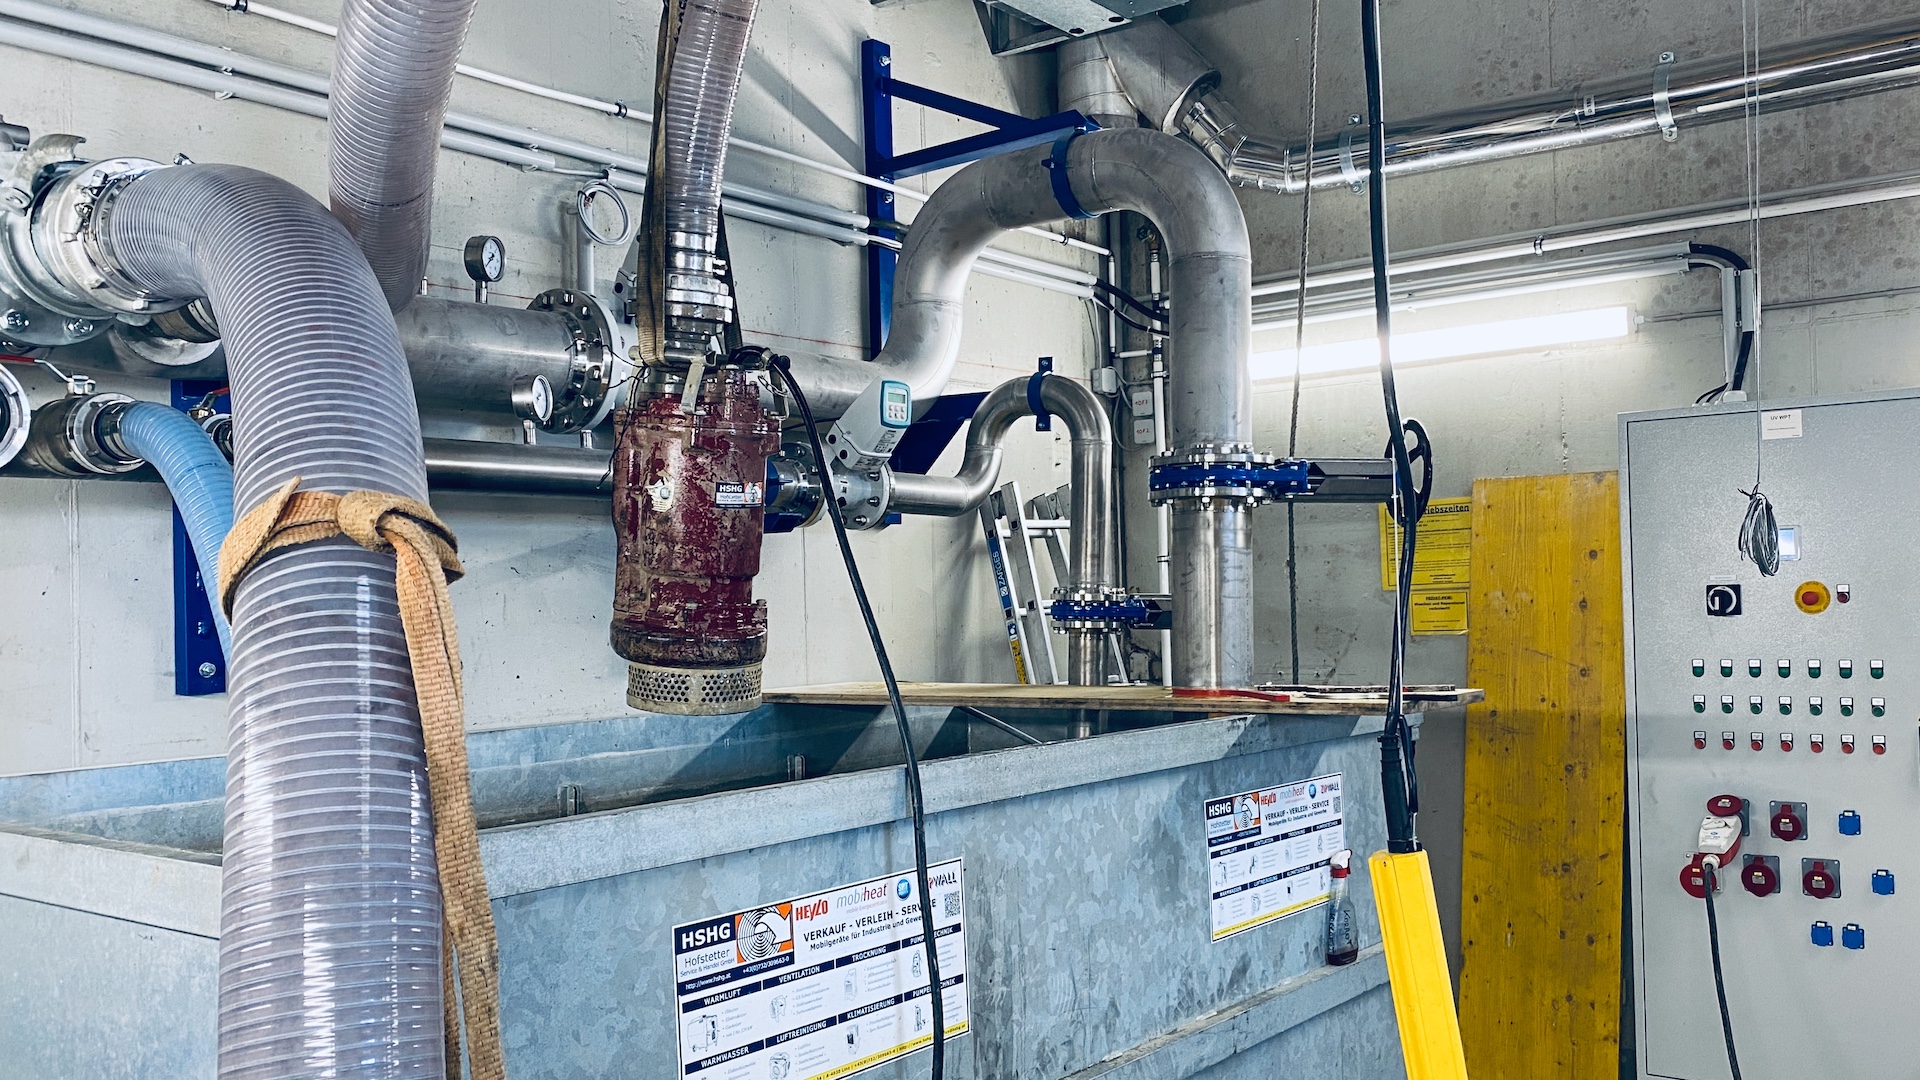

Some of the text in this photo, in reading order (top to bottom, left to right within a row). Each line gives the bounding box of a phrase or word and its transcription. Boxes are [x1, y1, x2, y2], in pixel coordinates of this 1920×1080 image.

[1424, 505, 1470, 514] riebszeiten
[993, 550, 1006, 586] ZARGES
[1208, 802, 1231, 817] HSHG
[1265, 810, 1285, 821] VERKAUF
[1289, 804, 1307, 815] VERLEIH
[1312, 800, 1330, 810] SERVICE
[836, 884, 887, 909] mobiheat
[928, 872, 957, 889] PWALL
[804, 922, 847, 942] VERKAUF
[855, 911, 893, 927] VERLEIH
[902, 898, 936, 916] SERVE
[682, 923, 731, 949] HSHG
[810, 935, 850, 951] Mobilgeräte
[851, 931, 860, 939] für
[862, 924, 892, 937] Industrie
[893, 920, 904, 929] und
[910, 926, 954, 945] PUMPECHNIK
[684, 949, 730, 968] Hofstetter
[852, 946, 887, 962] TROCKNUNG
[680, 967, 697, 977] Service
[703, 962, 720, 971] Handel
[720, 958, 735, 966] GmbH
[779, 966, 820, 983] VENTILATION
[704, 989, 741, 1005] WARMLUFT
[912, 978, 956, 998] PUMPECHNIK
[847, 998, 895, 1020] KLIMATISIERUNG
[777, 1021, 827, 1043] LUFTREINIGUNG
[700, 1046, 749, 1068] WARMWASSER
